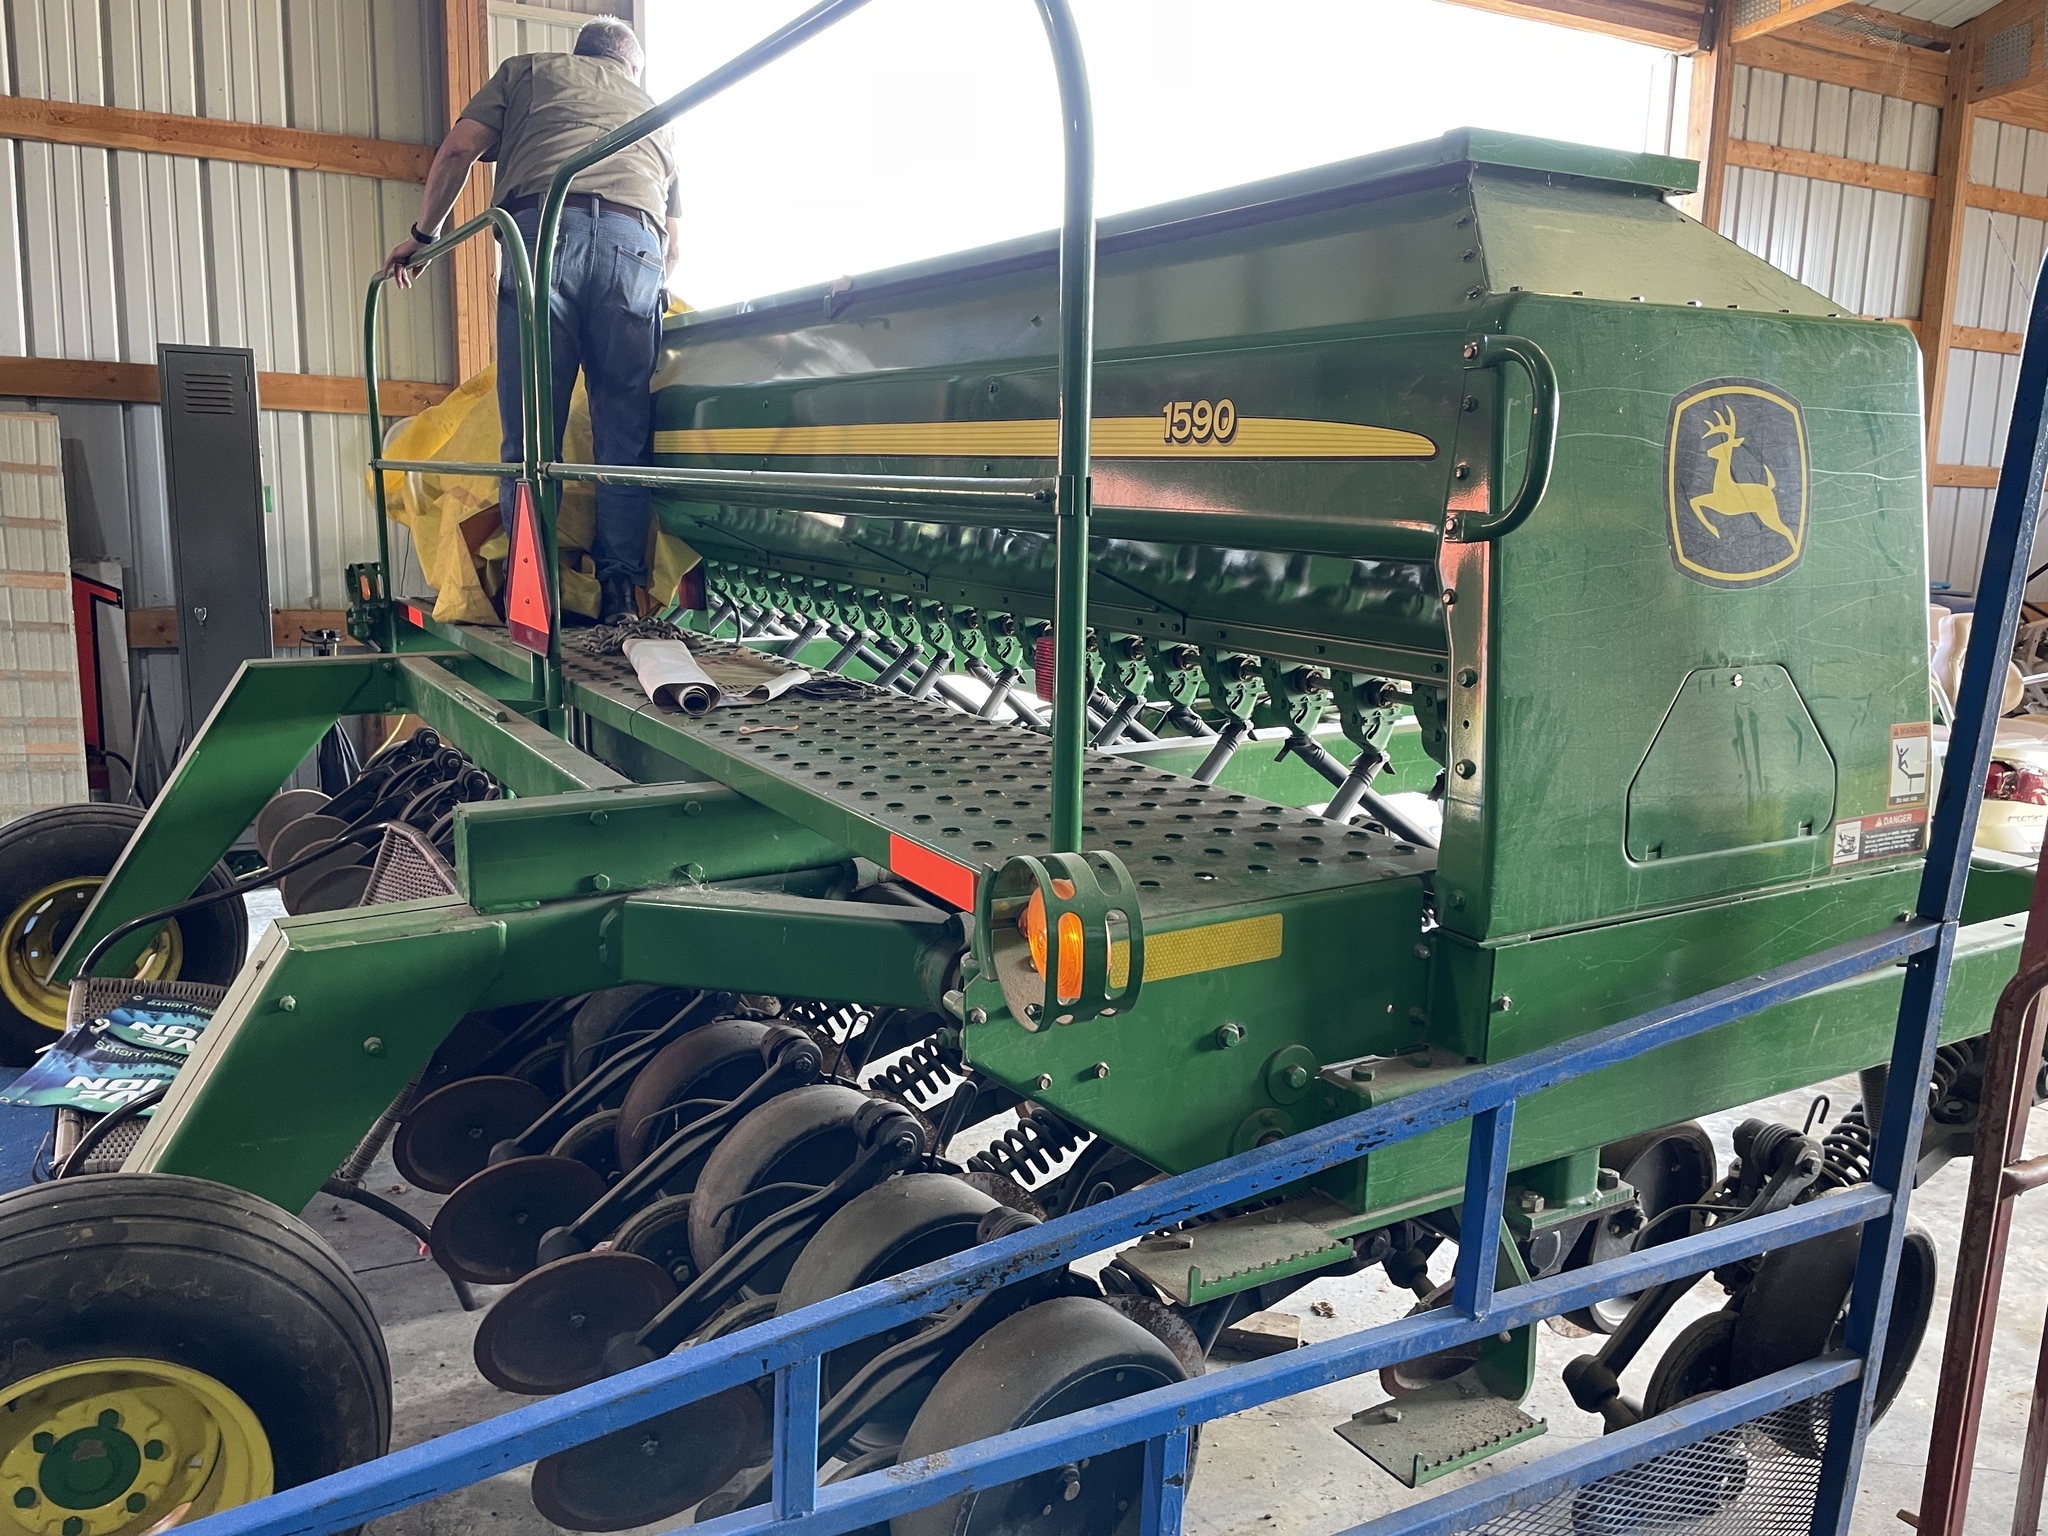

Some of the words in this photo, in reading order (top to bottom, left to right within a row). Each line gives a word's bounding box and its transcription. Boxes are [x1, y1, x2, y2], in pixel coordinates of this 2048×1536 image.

[1163, 398, 1237, 444] 1590
[1900, 725, 1928, 735] WARNING
[1883, 813, 1912, 826] DANGER
[128, 1021, 200, 1040] ON
[94, 1040, 140, 1057] LIGHTS
